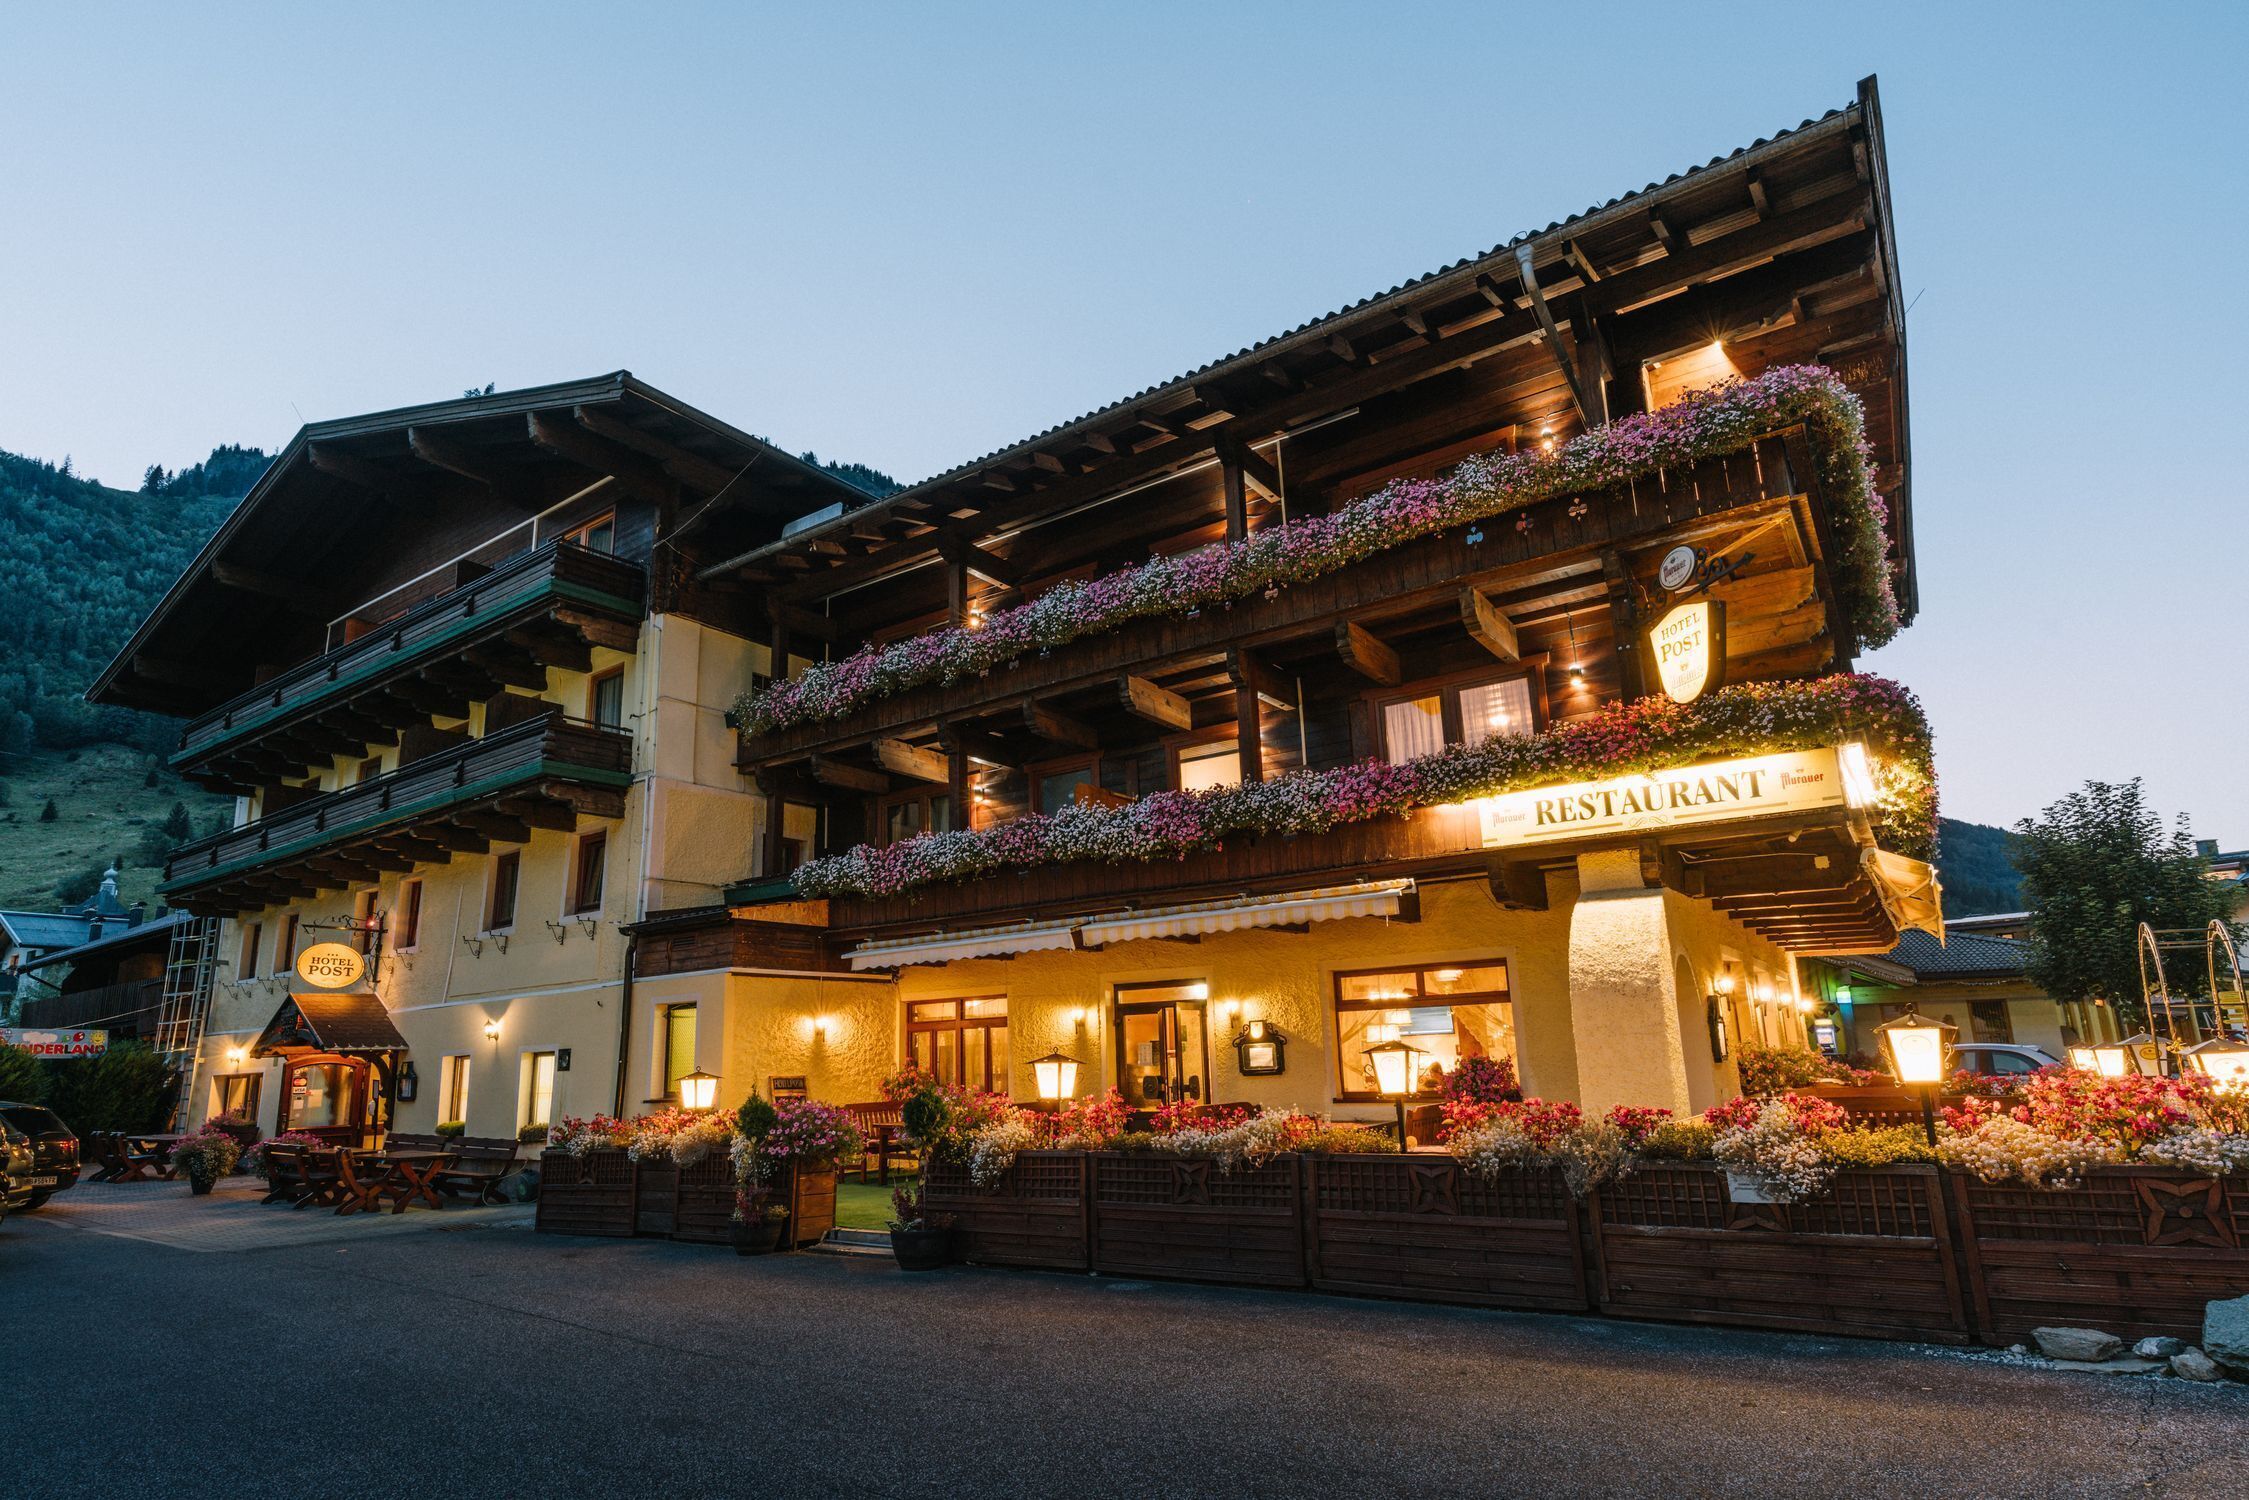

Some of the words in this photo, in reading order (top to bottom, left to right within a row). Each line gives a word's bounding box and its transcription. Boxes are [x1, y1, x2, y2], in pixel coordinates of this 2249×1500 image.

[1661, 612, 1700, 640] HOTEL
[1660, 630, 1701, 663] POST
[1780, 771, 1824, 789] Murauer
[1535, 768, 1766, 826] RESTAURANT
[308, 965, 355, 977] POST
[311, 956, 354, 967] HOTEL
